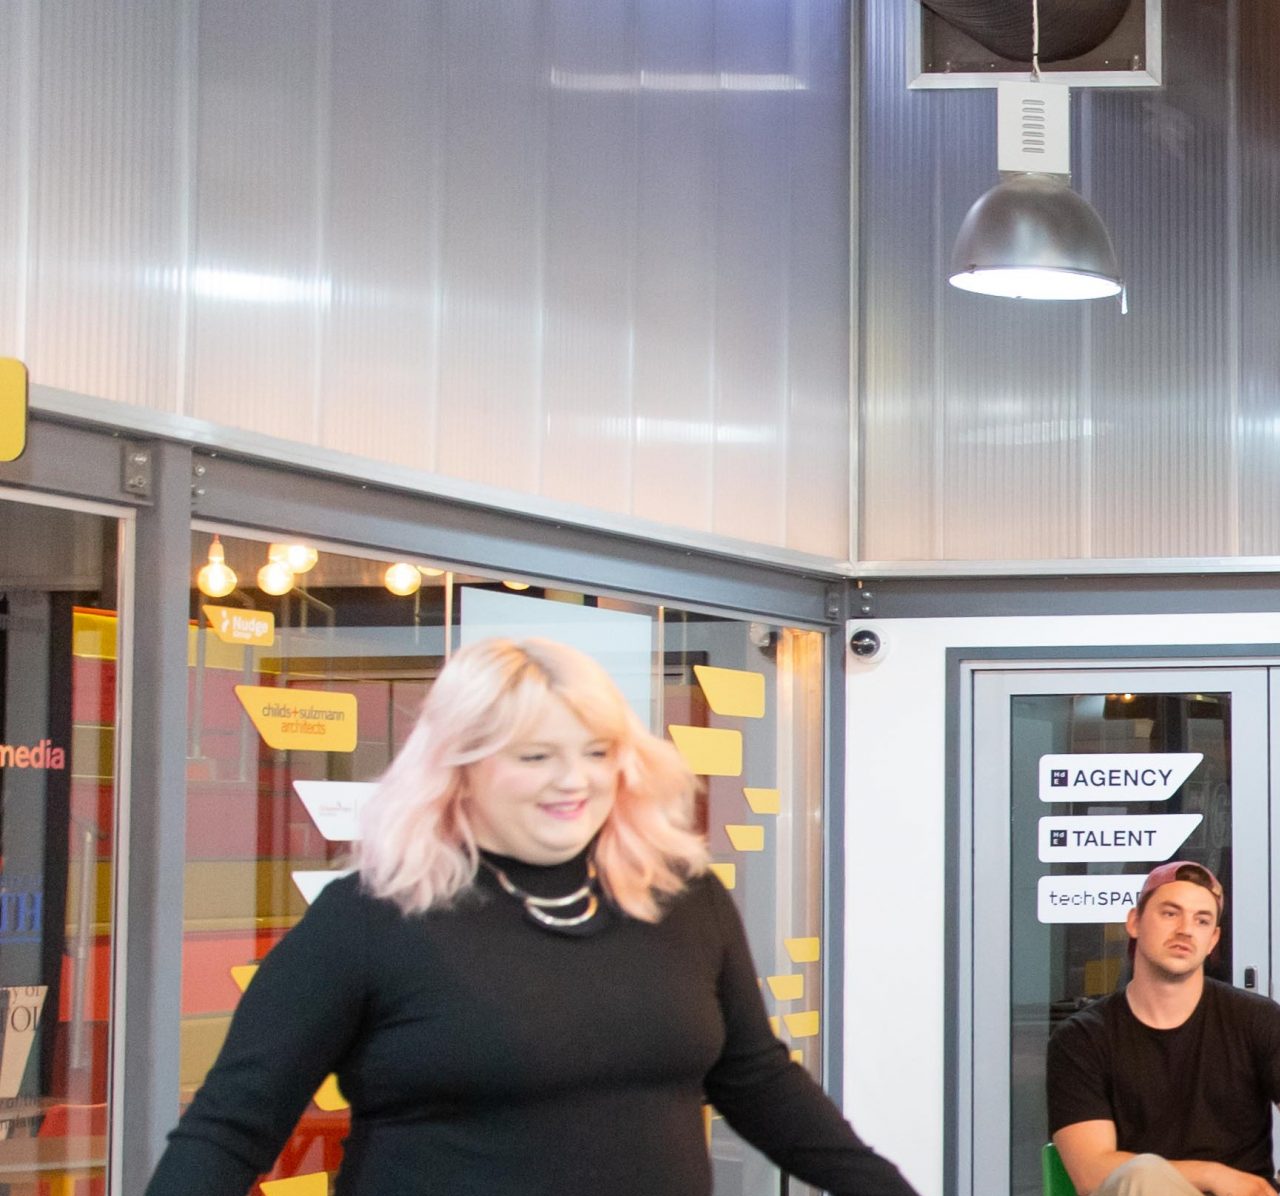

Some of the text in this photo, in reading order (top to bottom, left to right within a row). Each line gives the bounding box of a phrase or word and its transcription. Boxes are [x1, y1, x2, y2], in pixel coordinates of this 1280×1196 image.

[281, 719, 326, 735] architects
[1073, 769, 1173, 787] AGENCY
[1072, 830, 1157, 847] TALENT
